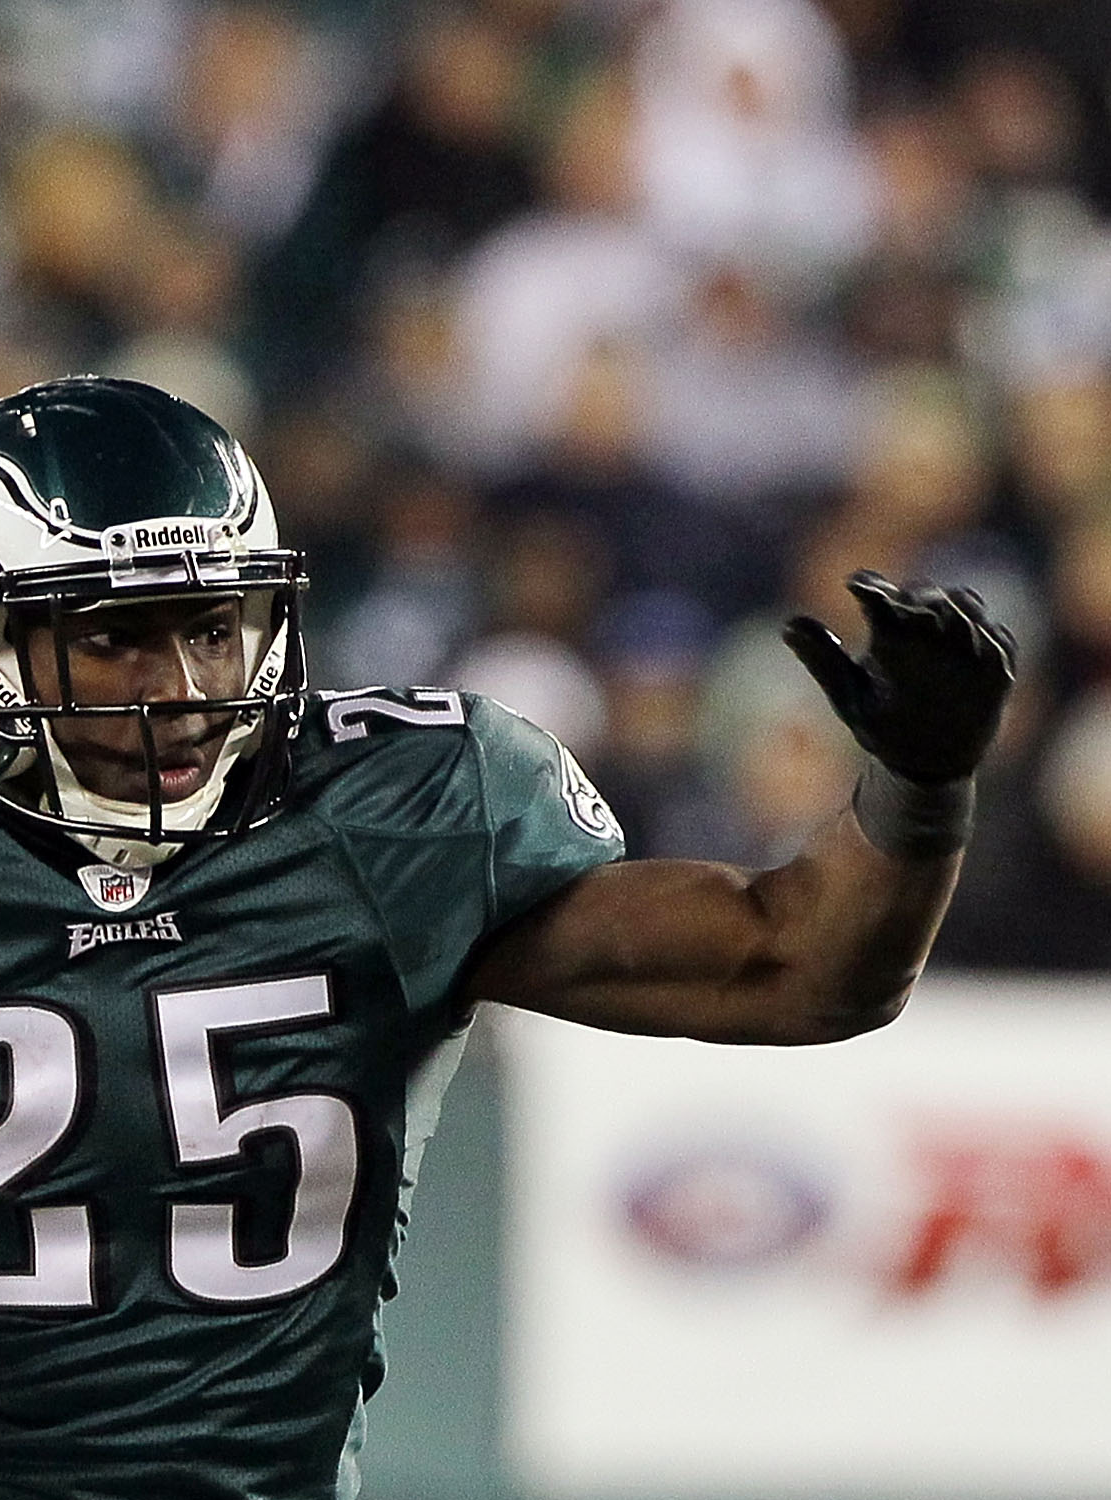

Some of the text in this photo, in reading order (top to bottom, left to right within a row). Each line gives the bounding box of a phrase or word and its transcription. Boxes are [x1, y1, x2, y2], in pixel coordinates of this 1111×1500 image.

[135, 525, 206, 548] Riddell
[103, 885, 134, 902] NFL
[66, 911, 183, 959] EAGLES
